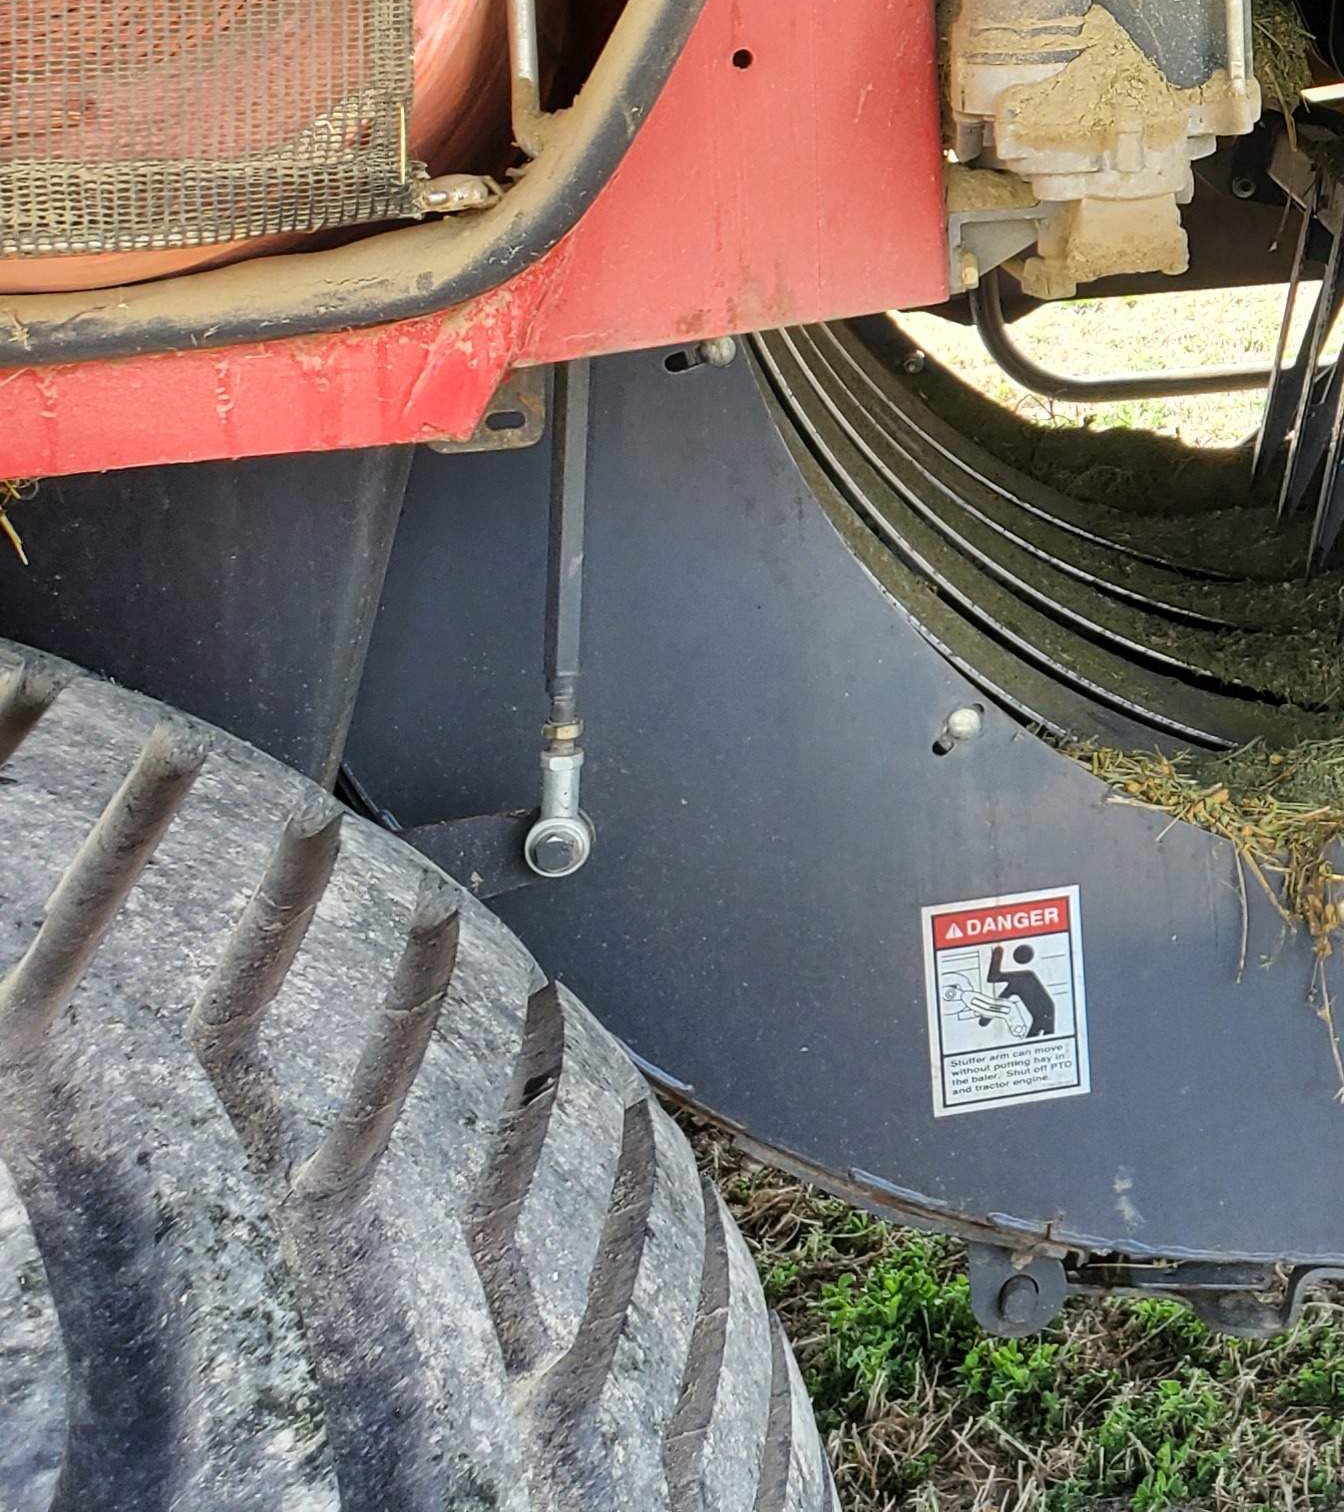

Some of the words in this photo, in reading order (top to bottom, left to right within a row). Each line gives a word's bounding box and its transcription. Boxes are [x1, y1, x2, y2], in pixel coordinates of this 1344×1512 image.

[966, 907, 1059, 936] DANGER
[950, 1054, 987, 1068] Stuffer
[989, 1051, 1010, 1062] arm
[1012, 1047, 1032, 1059] can
[1035, 1043, 1064, 1056] move
[951, 1063, 991, 1077] without
[993, 1057, 1031, 1073] putting
[1033, 1053, 1053, 1066] hay
[1055, 1051, 1066, 1061] in
[952, 1074, 969, 1086] the
[971, 1071, 1001, 1084] baler.
[1006, 1065, 1031, 1078] Shut
[1033, 1063, 1048, 1075] off
[1050, 1059, 1073, 1072] PTO
[952, 1085, 973, 1096] and
[974, 1078, 1010, 1093] tractor
